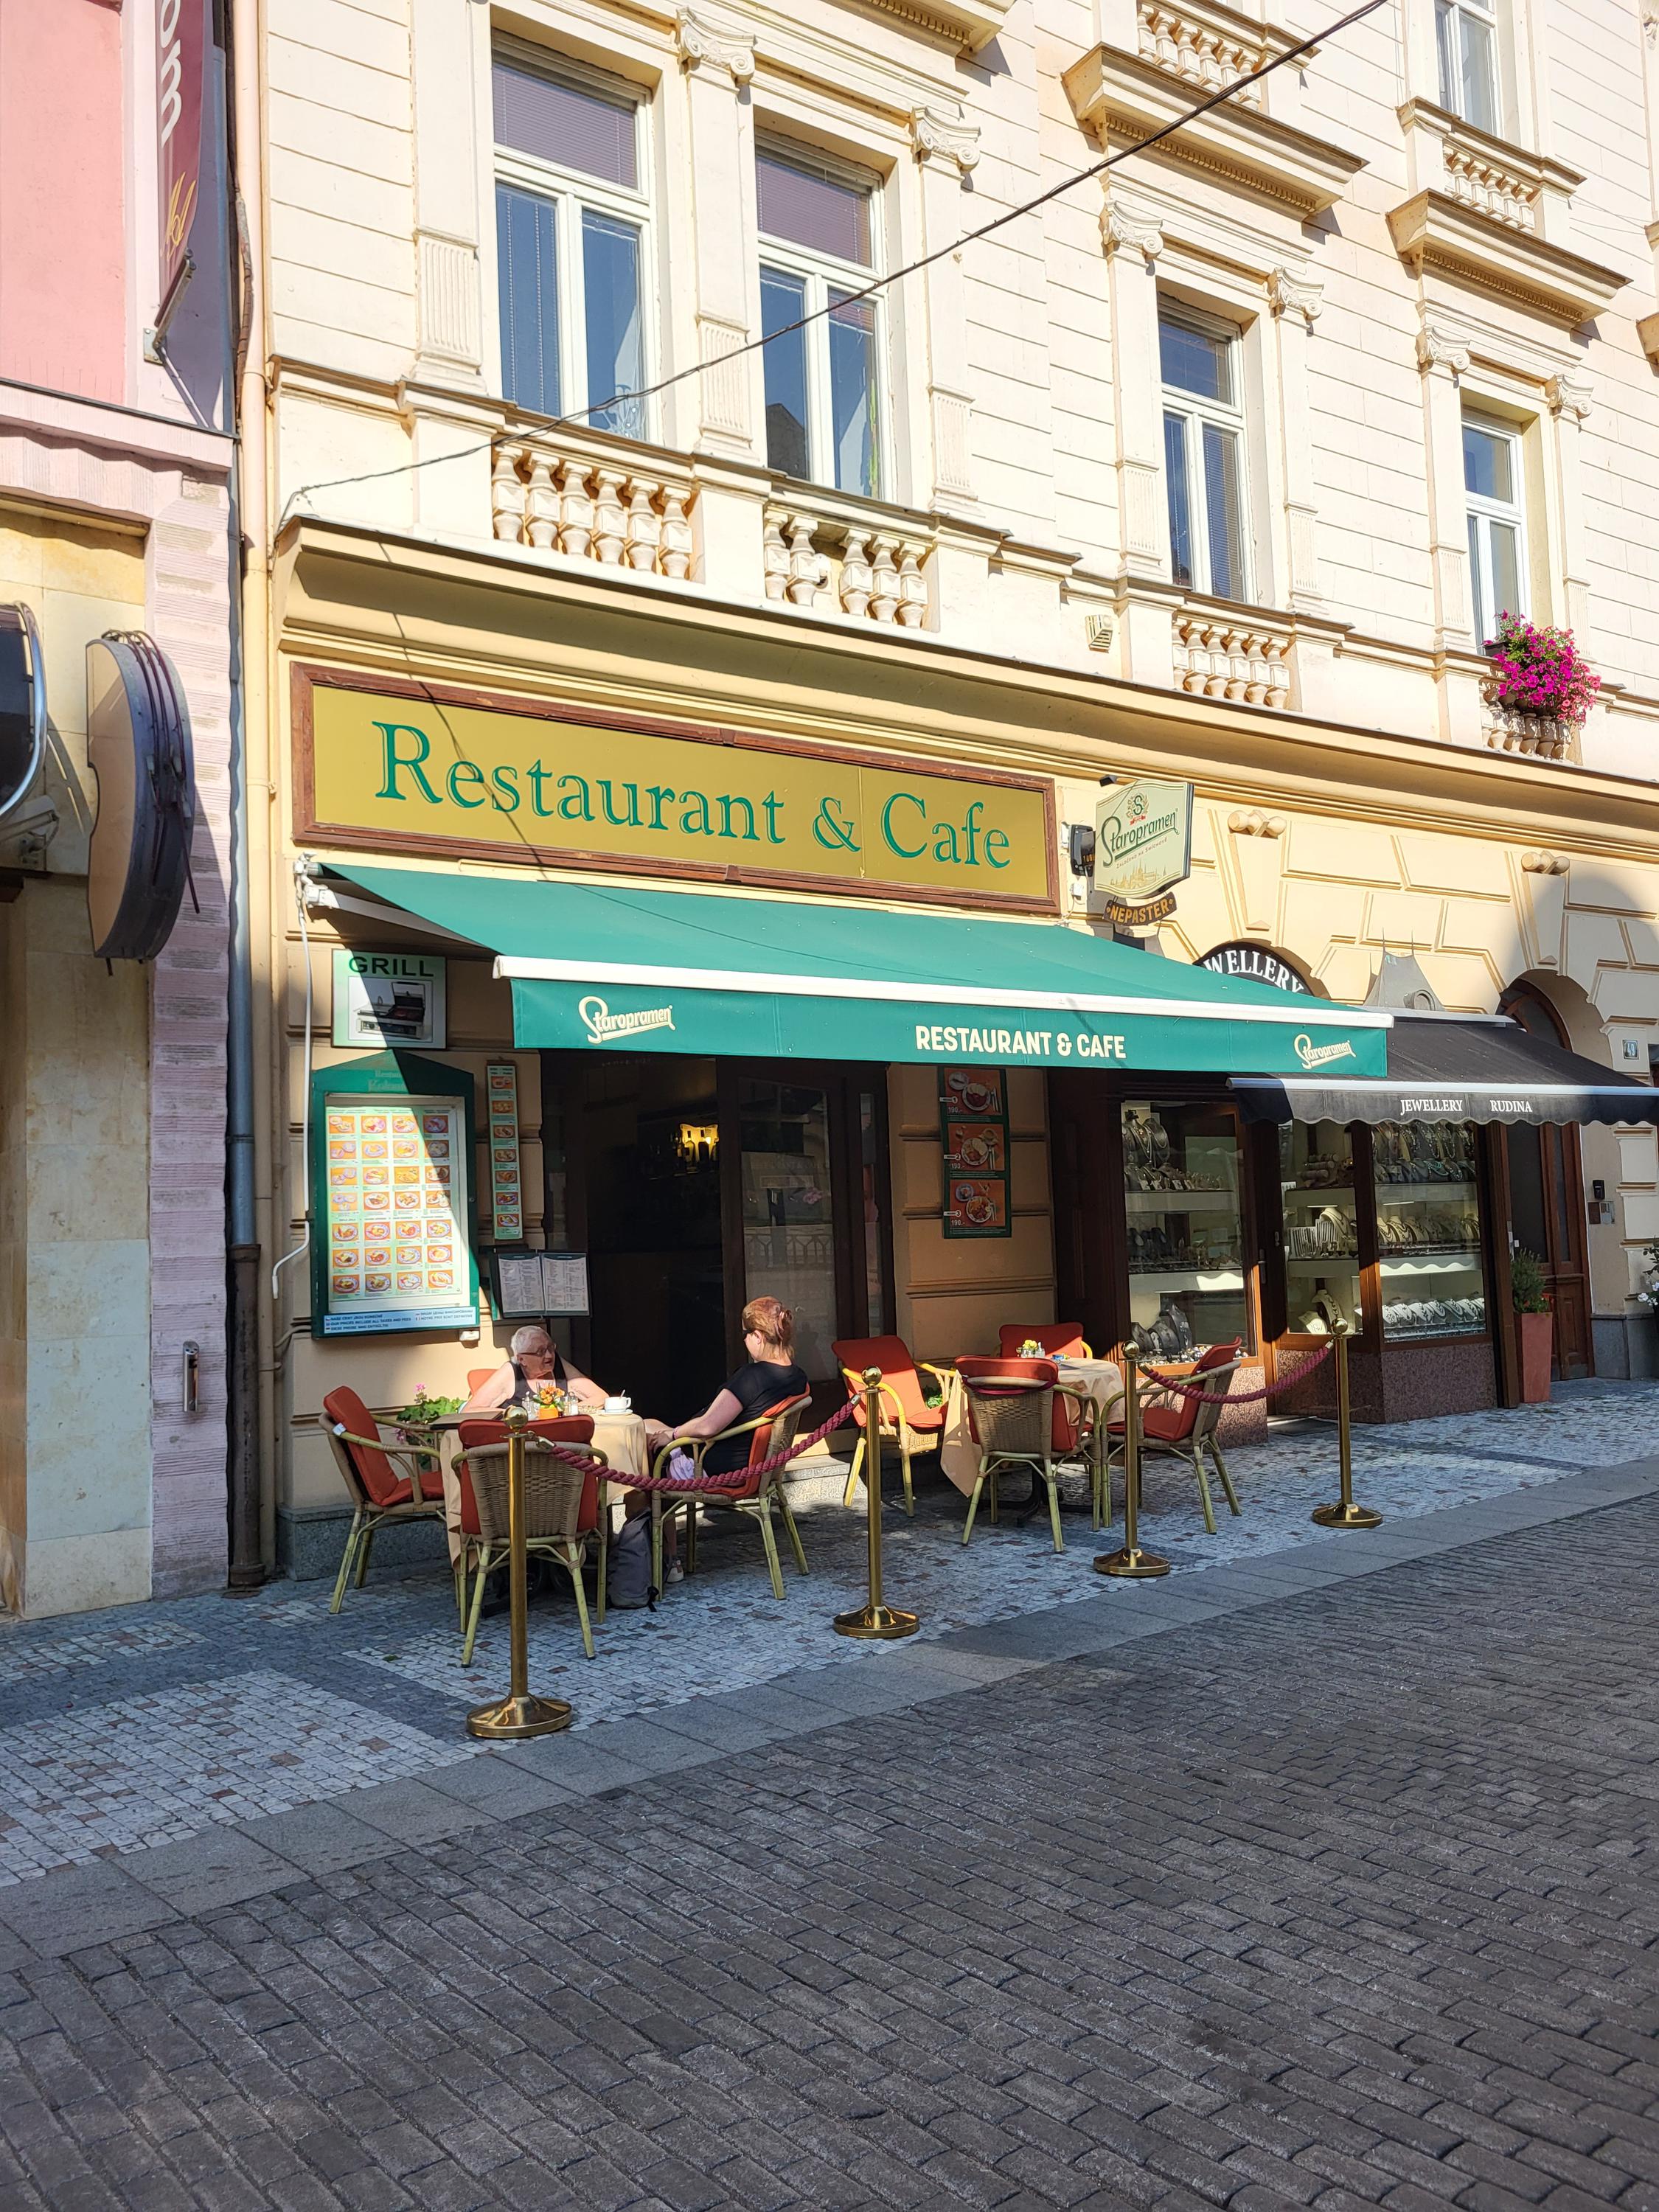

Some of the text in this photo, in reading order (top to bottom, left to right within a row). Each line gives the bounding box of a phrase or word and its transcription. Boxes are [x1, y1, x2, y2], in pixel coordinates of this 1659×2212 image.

[372, 720, 1011, 869] Restaurant & Cafe
[1101, 811, 1180, 868] Staropramen
[1110, 897, 1169, 923] NEPASTER
[349, 956, 434, 978] GRILL
[1203, 950, 1304, 993] WELLERY
[578, 995, 676, 1045] Staropramen
[915, 1025, 1127, 1058] RESTAURANT & CAFE
[1293, 1033, 1357, 1070] Staropramen
[1400, 1099, 1533, 1116] JEWELLERY RUDINA
